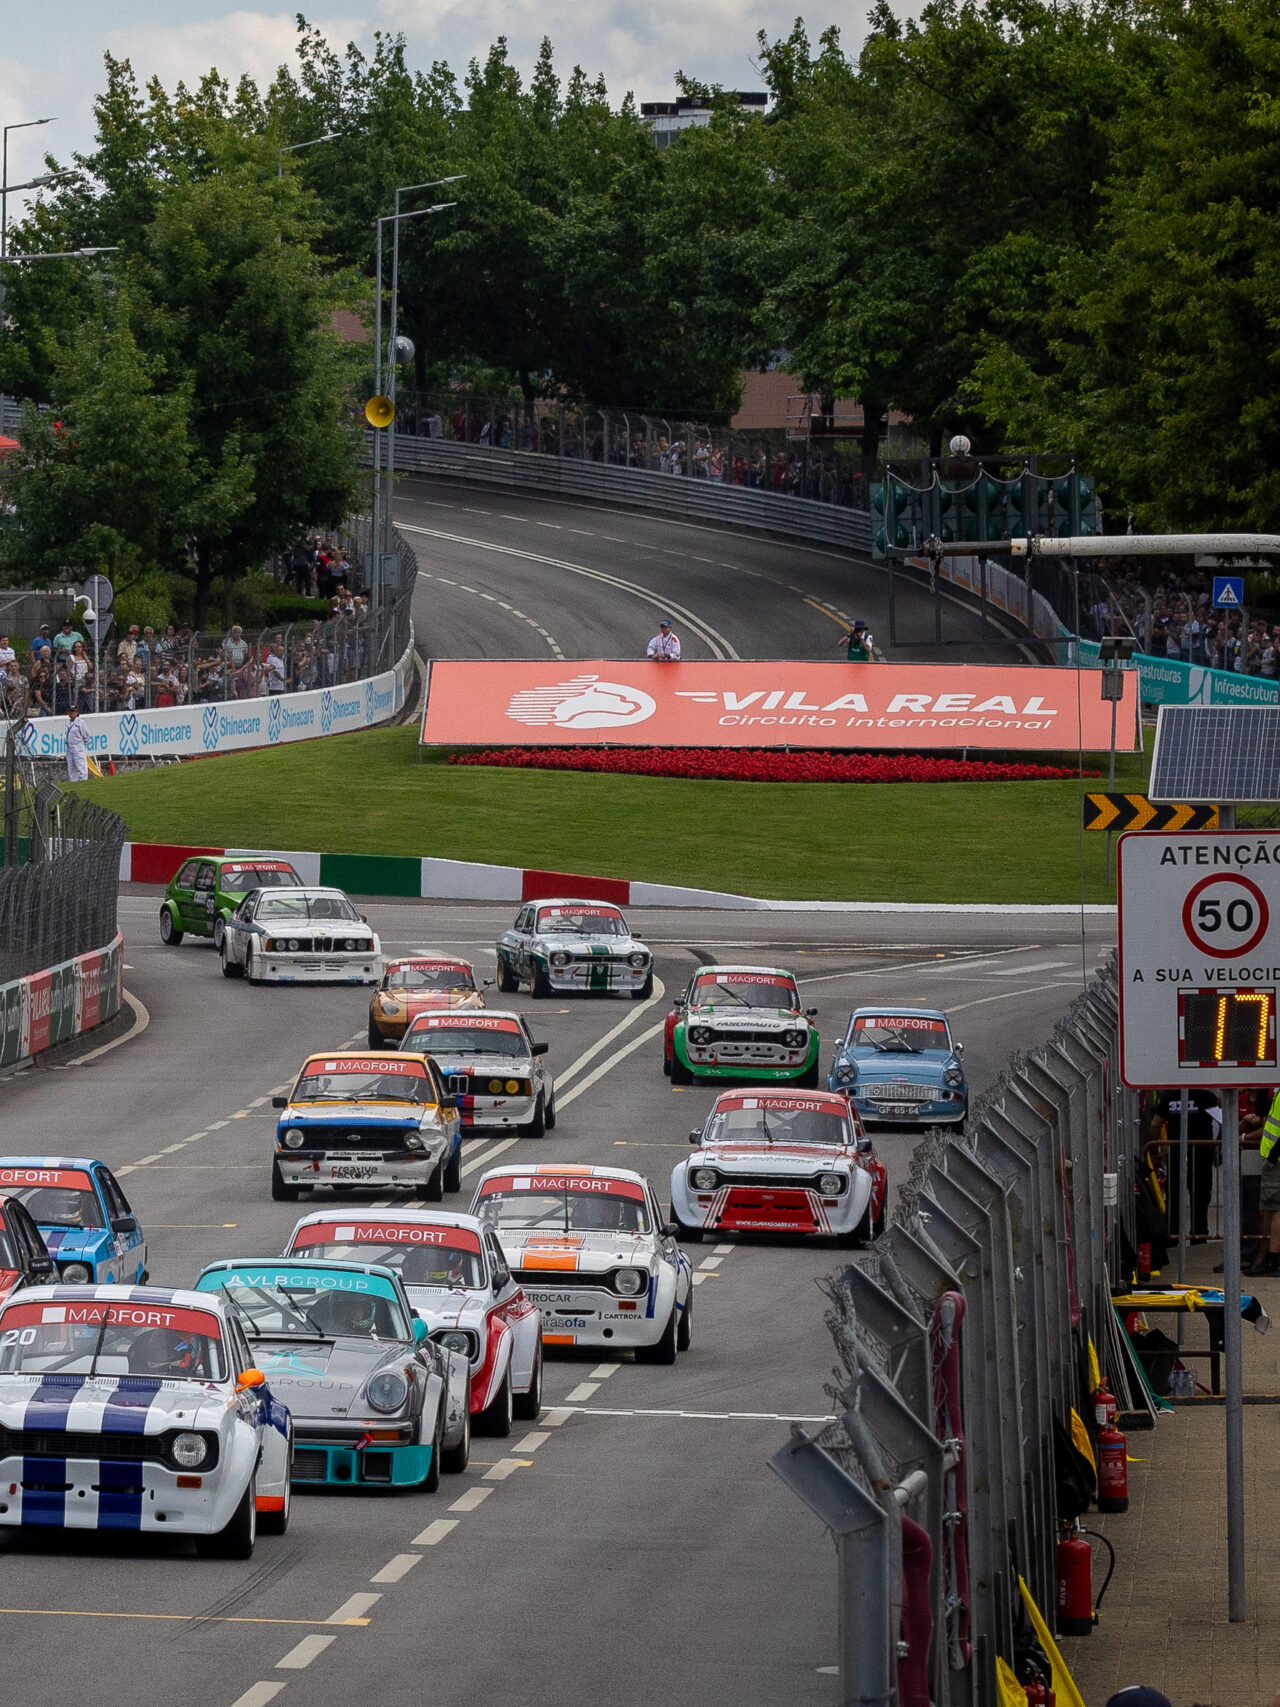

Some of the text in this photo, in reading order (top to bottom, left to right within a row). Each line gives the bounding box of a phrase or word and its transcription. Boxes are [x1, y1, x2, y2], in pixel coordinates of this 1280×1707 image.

[1214, 677, 1279, 704] Infraestrutura
[333, 700, 361, 718] Shinecare
[722, 690, 1058, 715] VILA REAL
[220, 716, 260, 737] Shinecare
[282, 709, 315, 729] Shinecare
[718, 714, 1053, 730] Circuito Internacional
[141, 724, 192, 745] Shinecare
[560, 908, 601, 916] MAQFORT
[1197, 899, 1254, 932] 50
[728, 976, 776, 985] MAQFORT
[1132, 968, 1280, 982] A SUA VELOCID
[441, 1018, 500, 1028] MAQFORT
[878, 1019, 935, 1030] MAQFORT
[1215, 994, 1269, 1060] 17
[339, 1062, 407, 1073] MAQFORT
[758, 1100, 822, 1111] MAQFORT
[532, 1179, 612, 1191] MAQFORT
[357, 1228, 447, 1244] MAQFORT
[246, 1274, 369, 1291] VLBGROUP
[68, 1308, 176, 1326] MAQFORT
[542, 1316, 586, 1328] irasofa
[1, 1328, 37, 1347] 20
